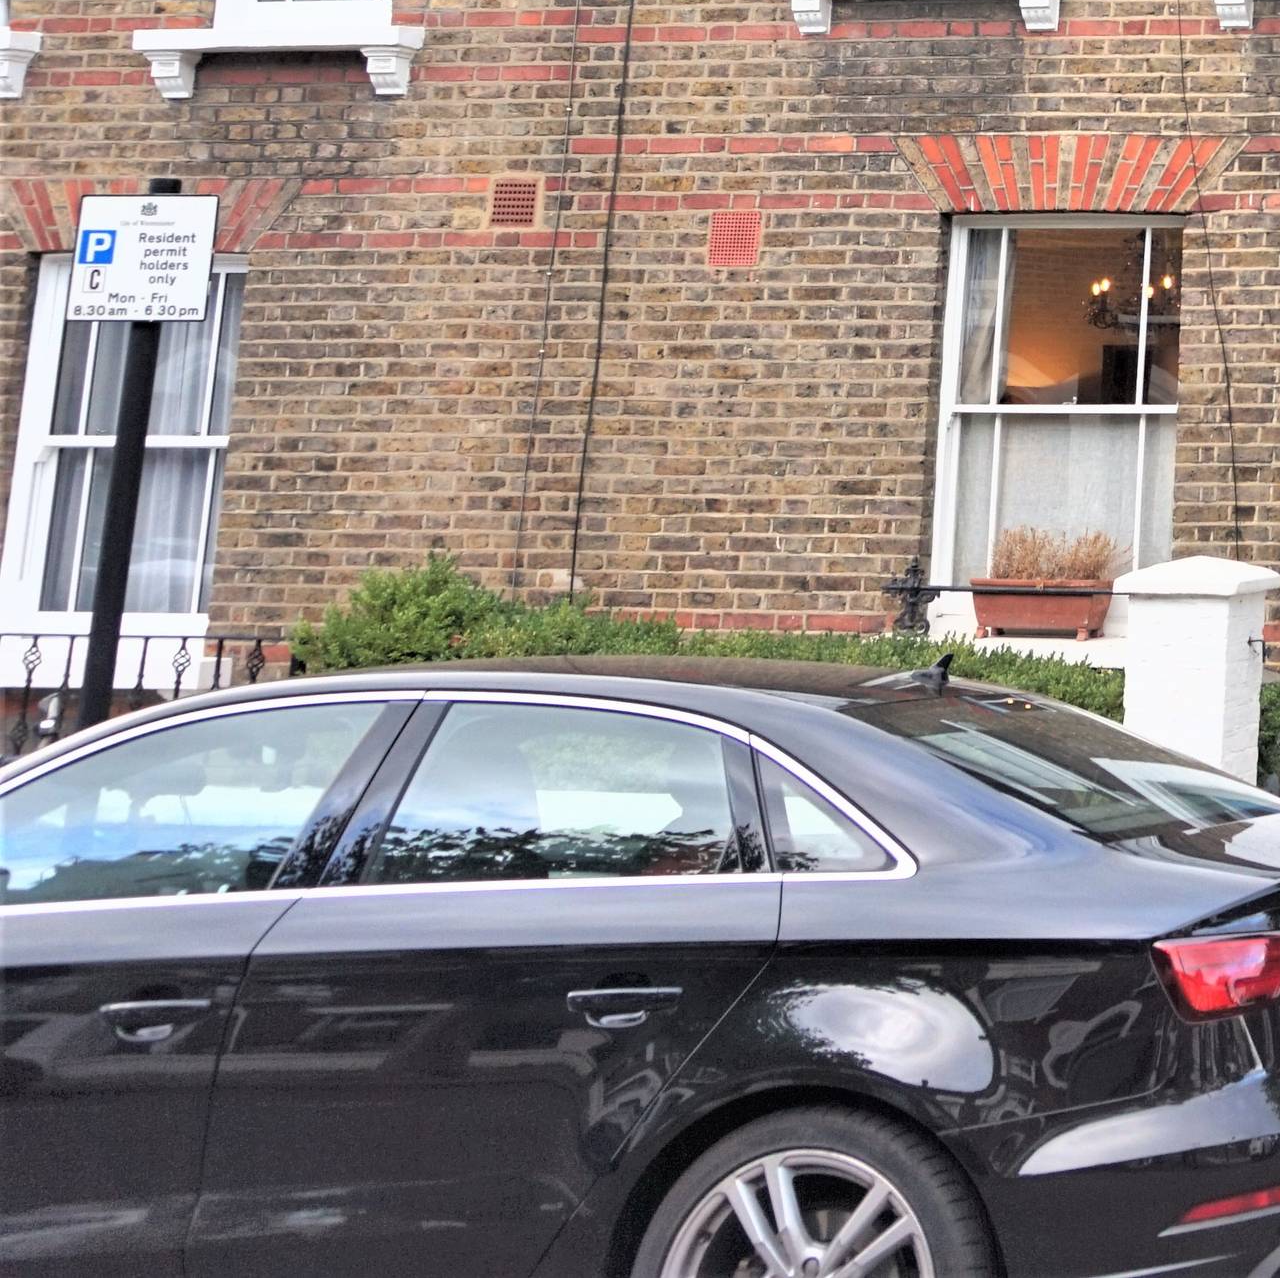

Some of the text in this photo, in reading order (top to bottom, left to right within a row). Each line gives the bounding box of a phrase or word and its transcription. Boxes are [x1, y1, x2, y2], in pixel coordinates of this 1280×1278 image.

[138, 232, 196, 243] Resident
[85, 232, 113, 262] P
[143, 246, 187, 258] permit
[140, 260, 189, 270] holders
[90, 269, 101, 290] C
[148, 273, 177, 286] only
[107, 292, 136, 303] Mon
[150, 292, 168, 303] Fri
